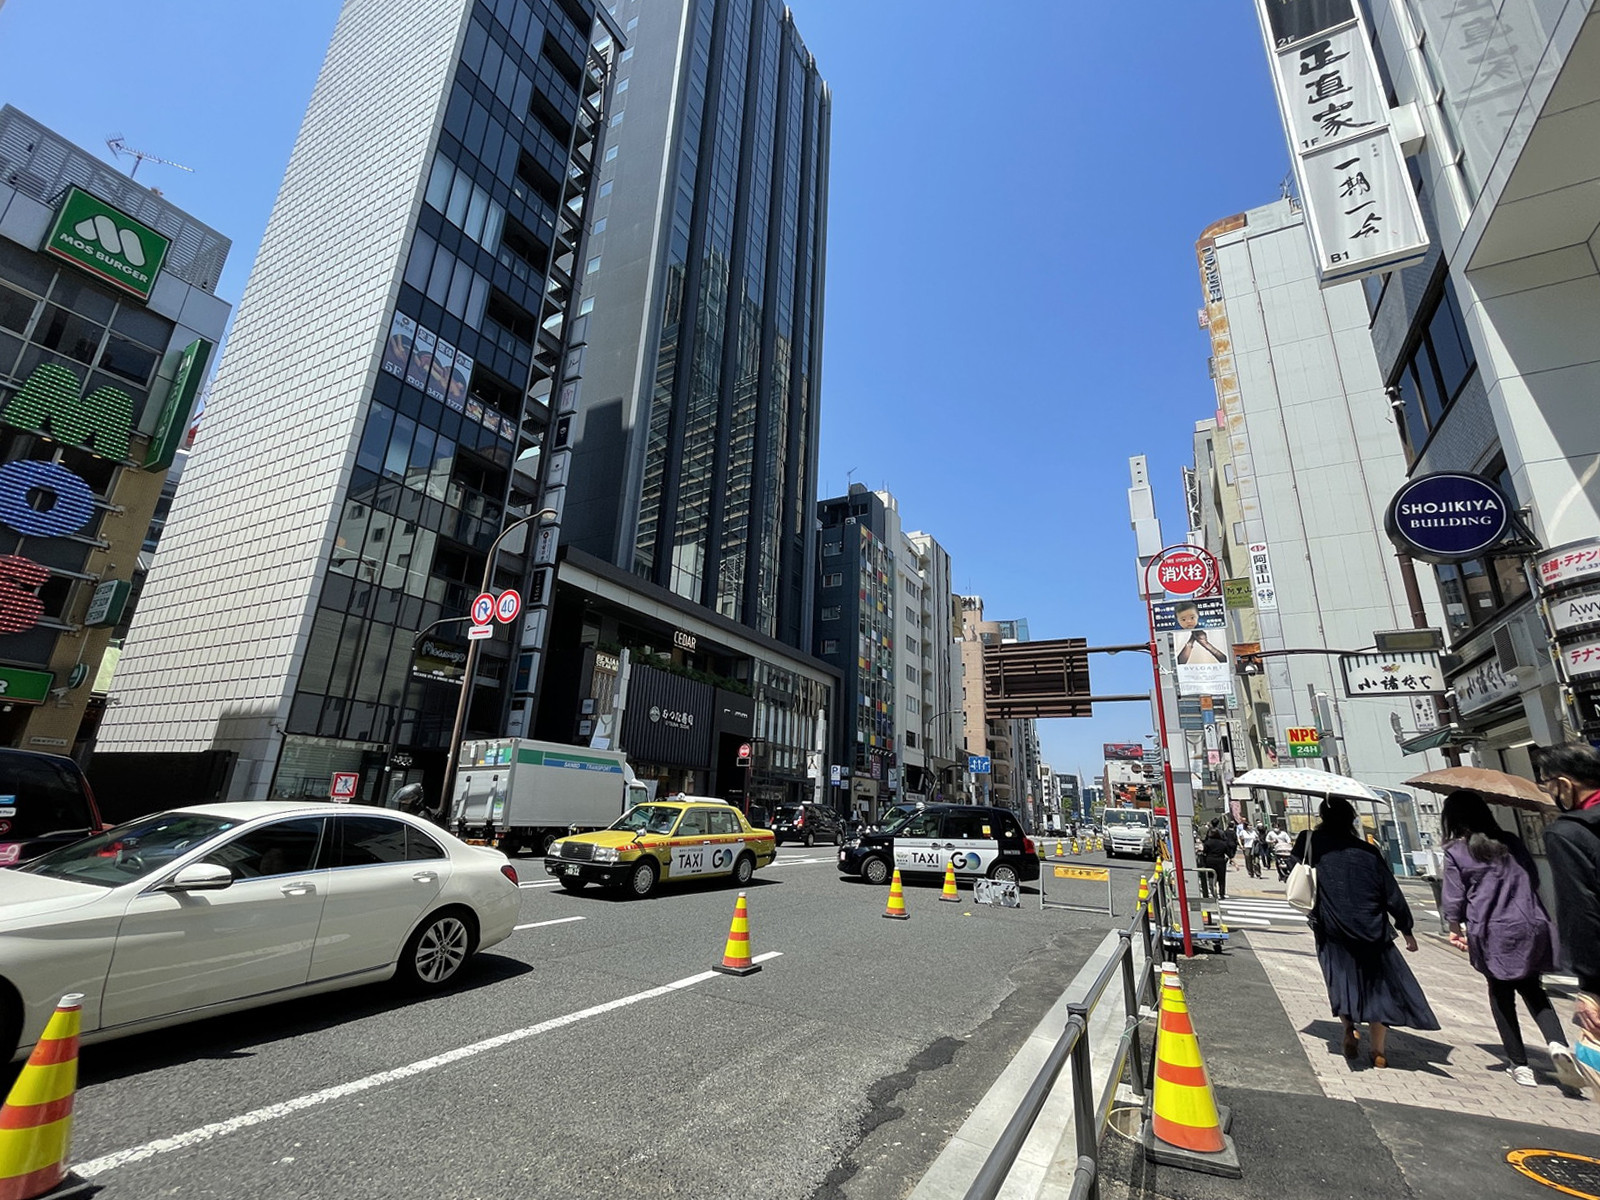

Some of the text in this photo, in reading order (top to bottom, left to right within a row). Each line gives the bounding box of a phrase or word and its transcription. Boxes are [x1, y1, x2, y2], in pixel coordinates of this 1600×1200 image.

[1278, 35, 1295, 47] 2F
[1299, 40, 1377, 137] 正直家
[1302, 137, 1319, 149] 1F
[1333, 157, 1382, 240] 一期一会
[60, 232, 150, 284] MOS BURGER
[1330, 251, 1350, 264] B1
[384, 361, 402, 376] 5F
[1401, 499, 1498, 515] SHOJIKIYA
[1410, 516, 1492, 529] BUILDING
[1161, 564, 1204, 583] 消火栓
[1253, 554, 1271, 585] 阿里山
[500, 599, 514, 613] 40
[673, 631, 697, 649] CEDAR
[586, 764, 612, 772] TRANSPORT
[678, 848, 733, 869] TAXI GO
[911, 852, 939, 864] TAXI
[950, 851, 982, 870] GO
